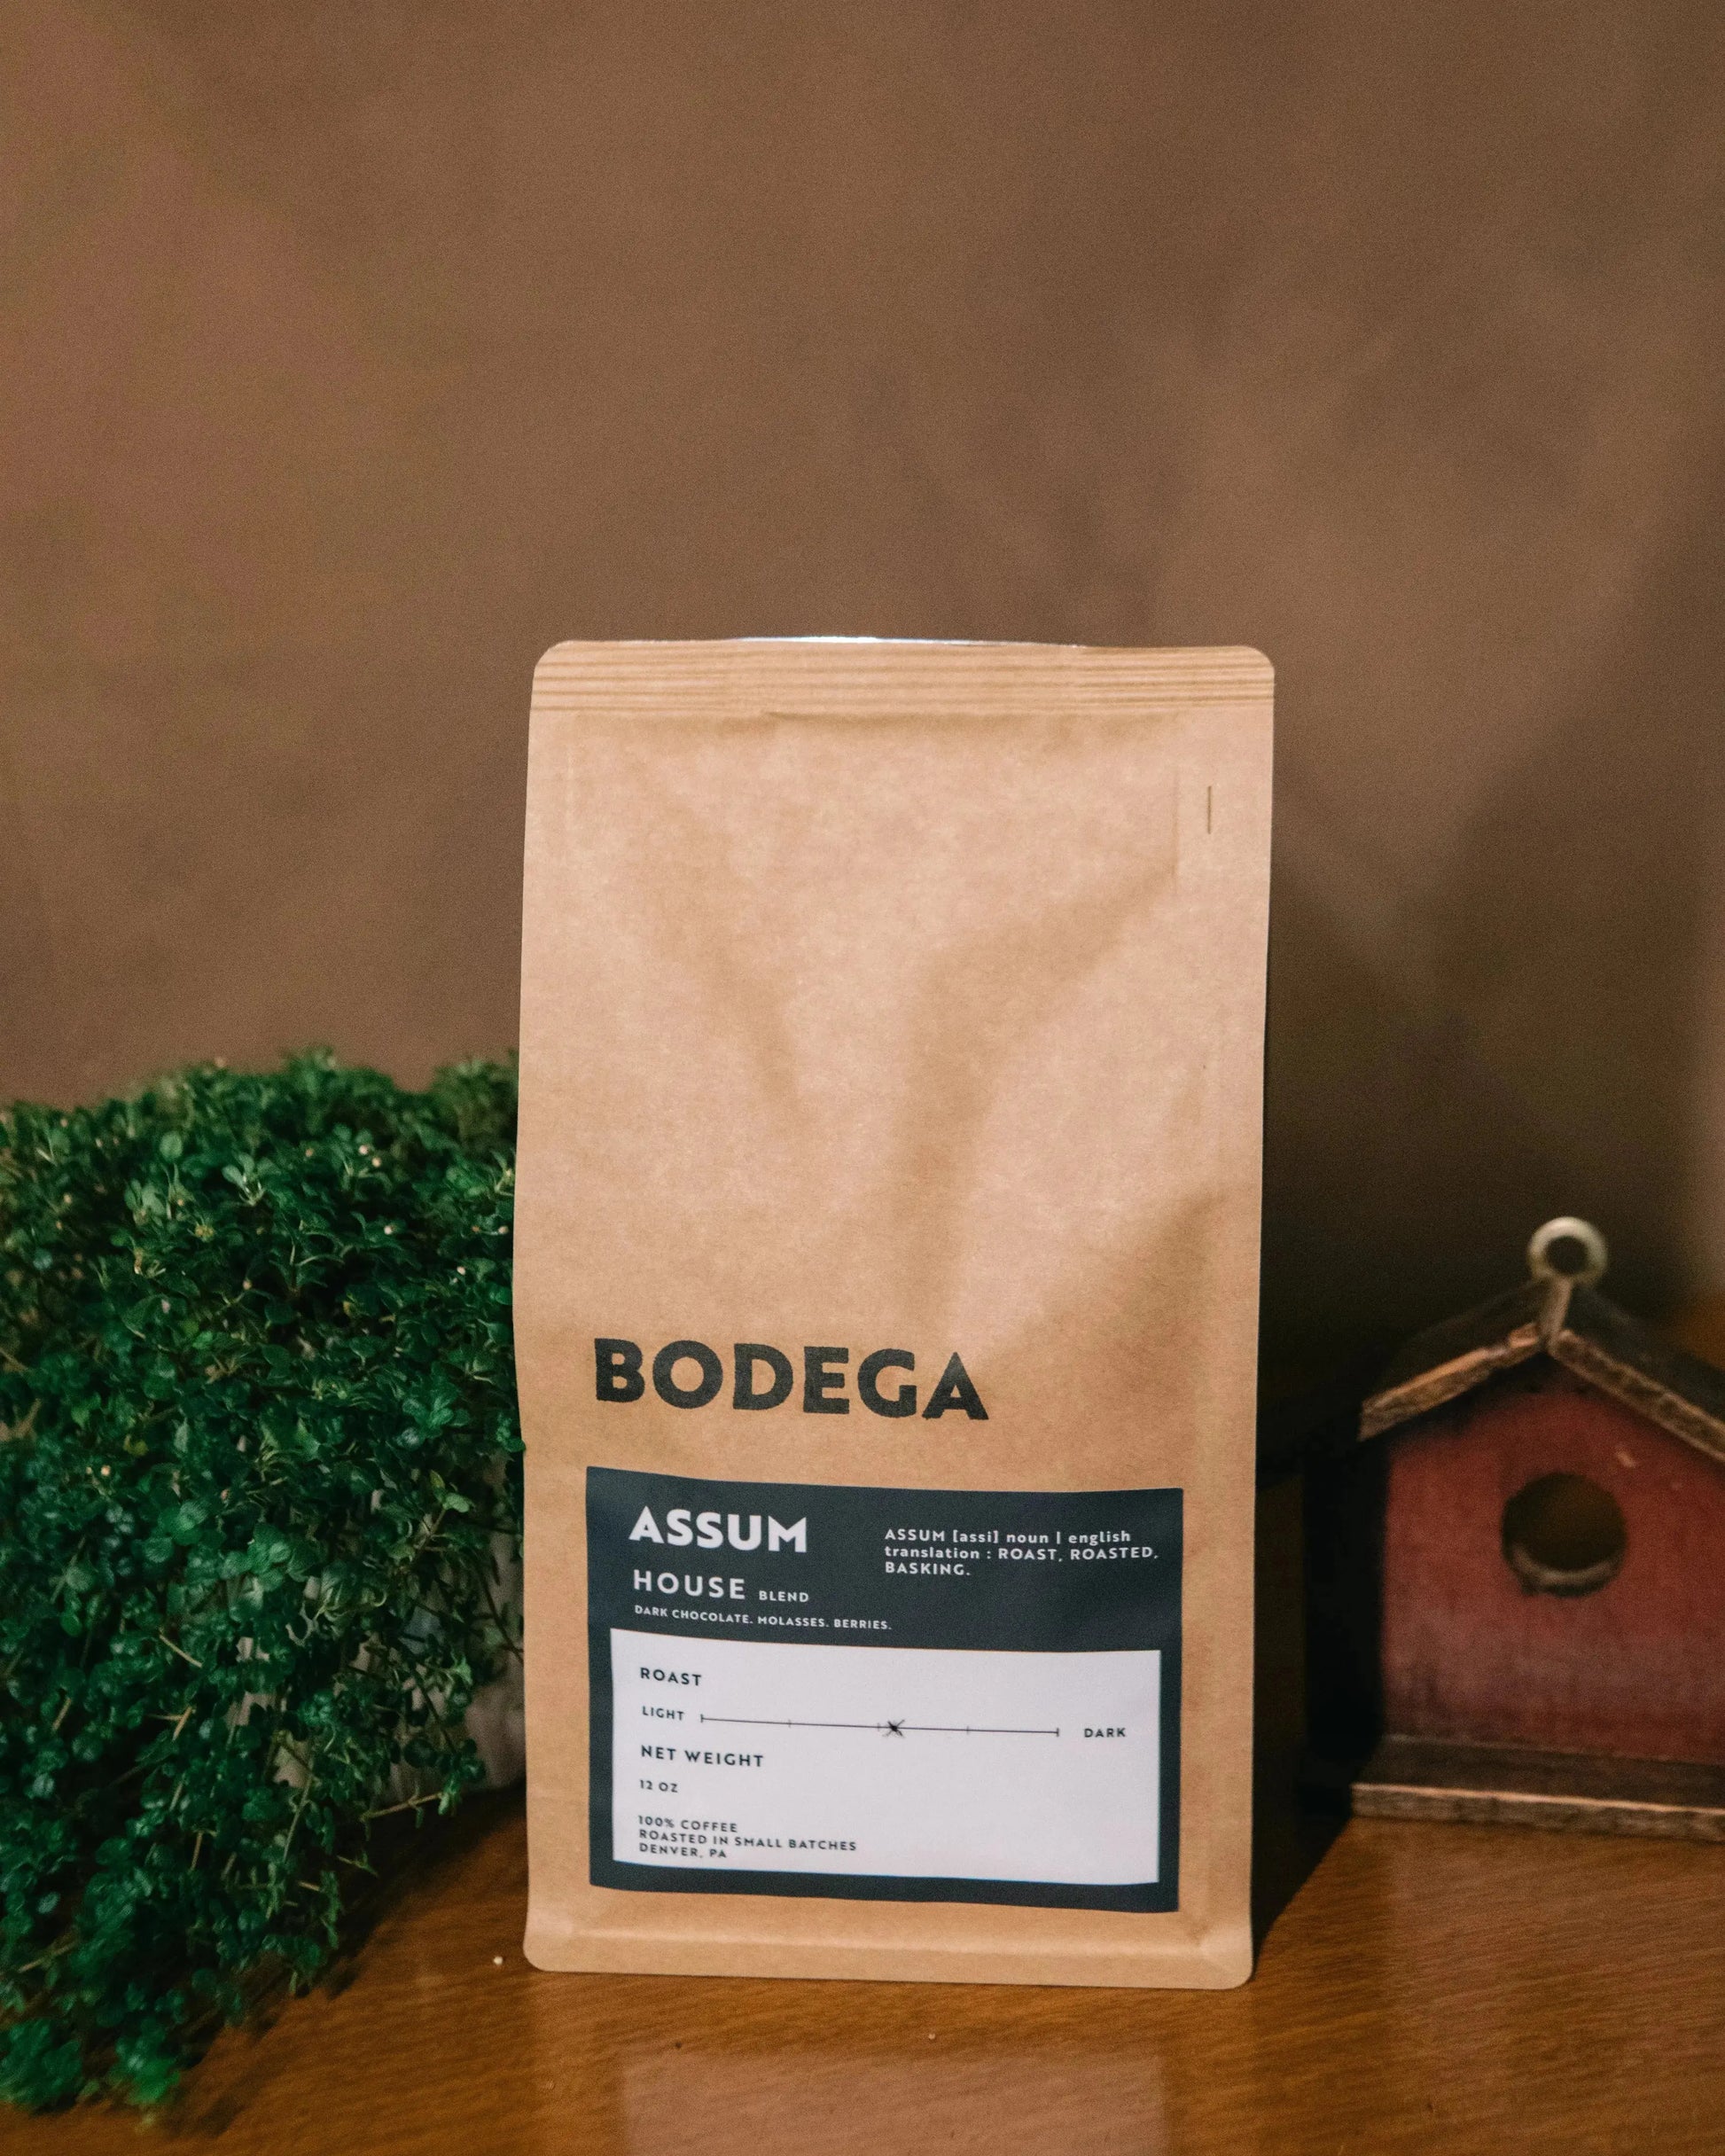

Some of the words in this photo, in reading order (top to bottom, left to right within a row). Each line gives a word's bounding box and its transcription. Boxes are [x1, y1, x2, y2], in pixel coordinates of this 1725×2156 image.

[594, 1338, 989, 1421] BODEGA
[628, 1505, 807, 1553] ASSUM
[885, 1528, 945, 1543] ASSUM
[952, 1529, 999, 1544] [assi]
[1006, 1532, 1049, 1544] noun
[1068, 1530, 1131, 1546] english
[885, 1545, 980, 1559] translation
[998, 1548, 1063, 1562] ROAST,
[1070, 1546, 1159, 1560] ROASTED,
[885, 1561, 971, 1576] BASKING.
[633, 1569, 745, 1600] HOUSE
[759, 1590, 809, 1603] BLEND
[635, 1605, 667, 1617] DARK
[672, 1609, 753, 1625] CHOCOLATE.
[757, 1615, 829, 1629] MOLASSES.
[833, 1618, 892, 1630] BERRIES.
[640, 1667, 702, 1686] ROAST
[643, 1706, 684, 1721] LIGHT
[1083, 1728, 1126, 1738] DARK
[641, 1745, 676, 1761] NET
[684, 1750, 764, 1768] WEIGHT
[639, 1779, 652, 1790] 12
[659, 1782, 678, 1793] OZ
[637, 1815, 675, 1828] 100%
[681, 1820, 738, 1833] COFFEE
[639, 1829, 706, 1845] ROASTED
[714, 1836, 729, 1846] IN
[734, 1837, 782, 1848] SMALL
[789, 1840, 857, 1851] BATCHES
[639, 1842, 703, 1858] DENVER,
[710, 1848, 727, 1858] PA
